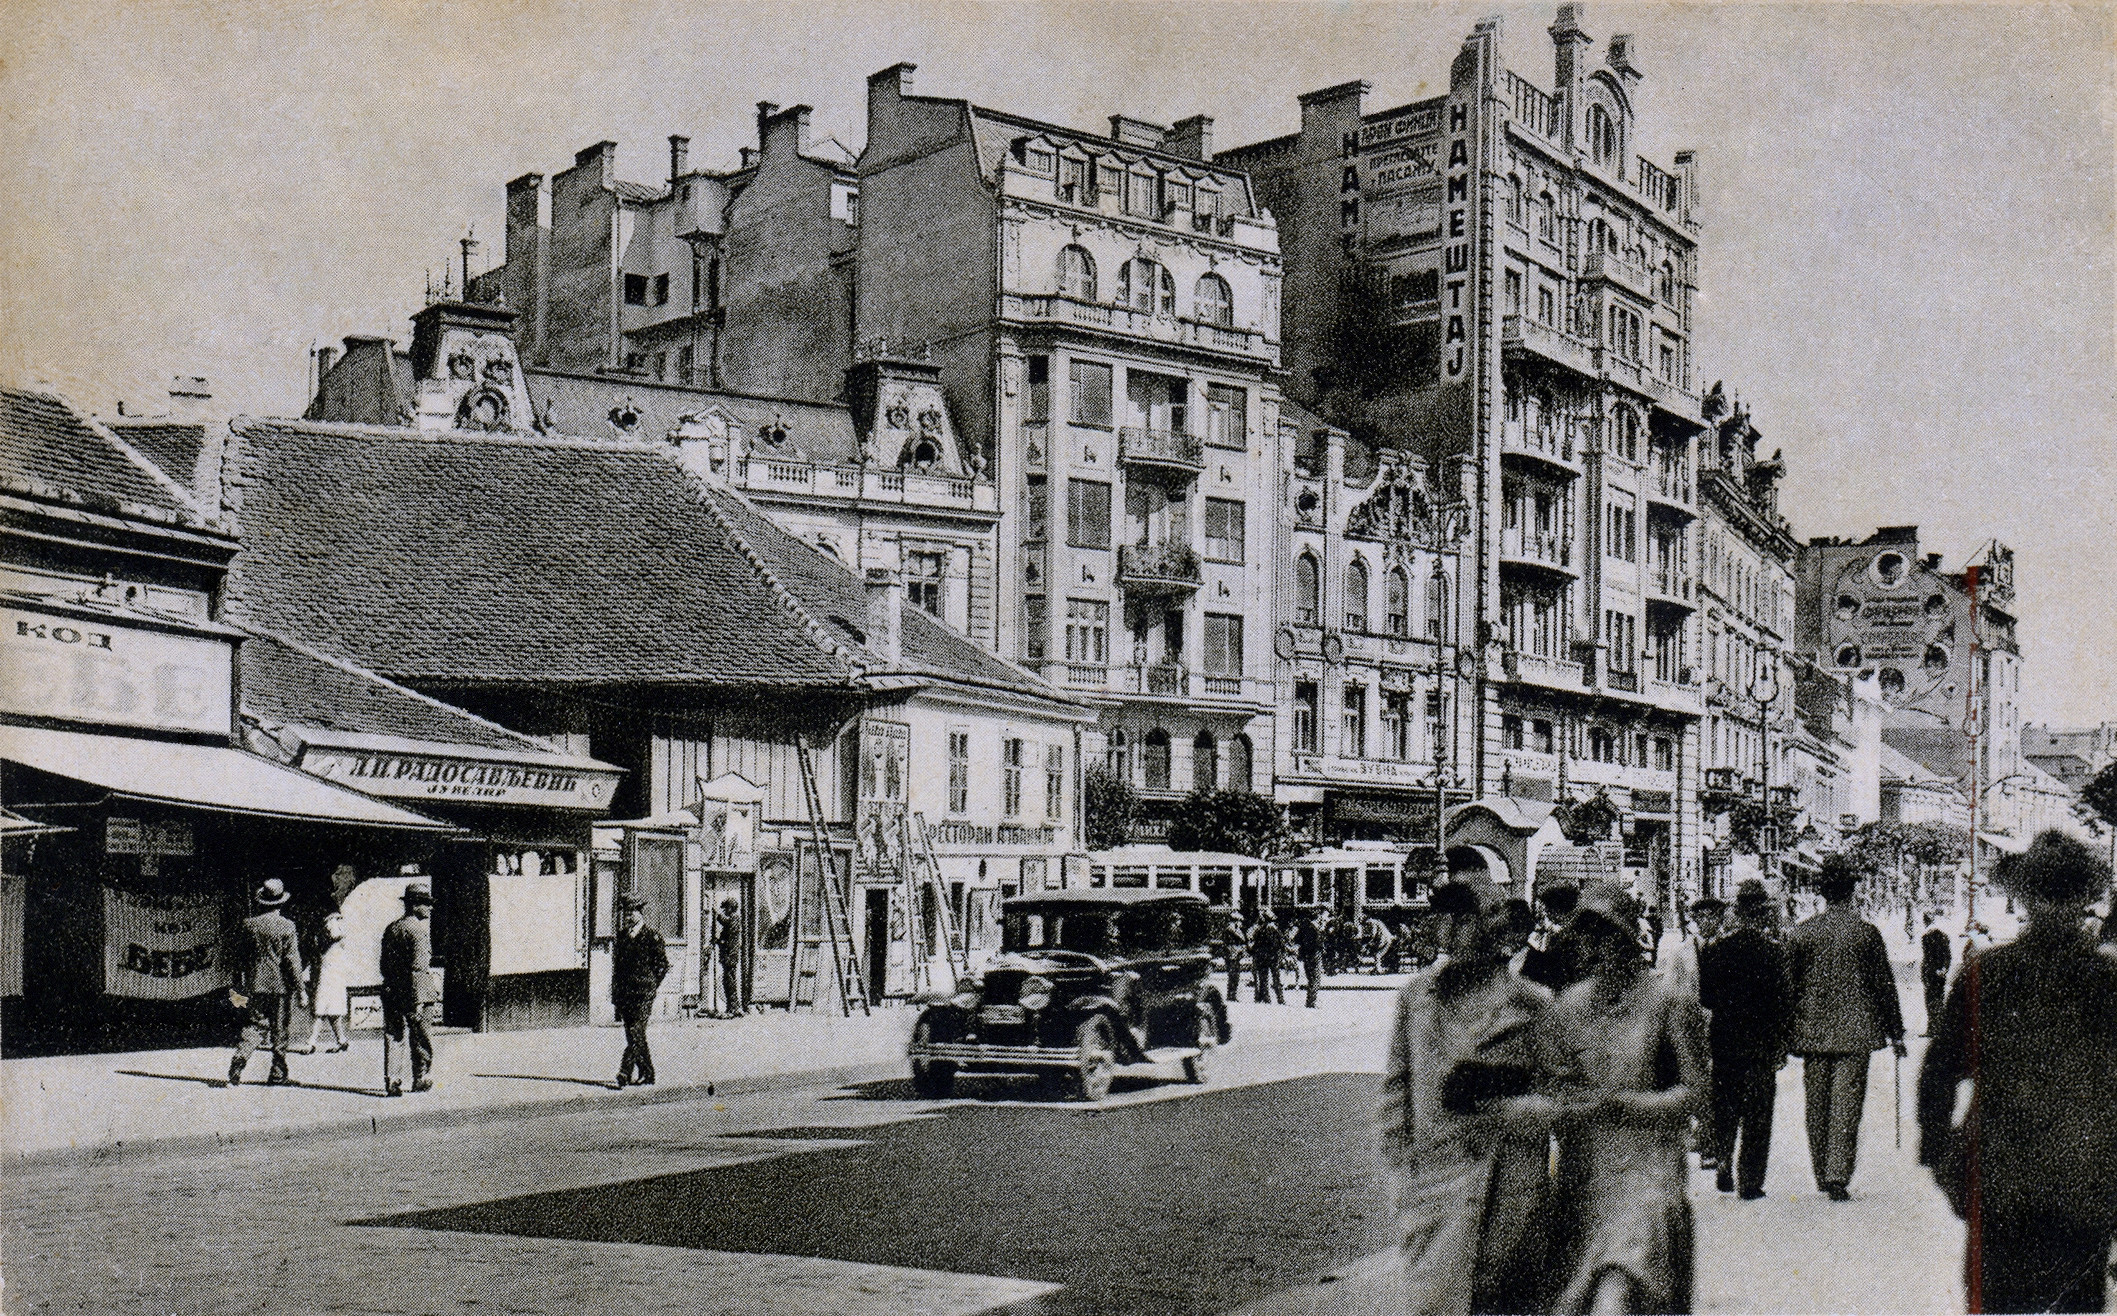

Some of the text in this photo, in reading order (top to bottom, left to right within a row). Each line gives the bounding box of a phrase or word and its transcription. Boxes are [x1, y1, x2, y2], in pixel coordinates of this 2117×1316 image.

[1446, 104, 1468, 376] НАМЕШТАЈ
[16, 620, 113, 651] КОД
[0, 643, 210, 720] ЕБЕ
[426, 785, 507, 797] ЈУВЕЛИР
[928, 824, 994, 845] РЕСТОРАН
